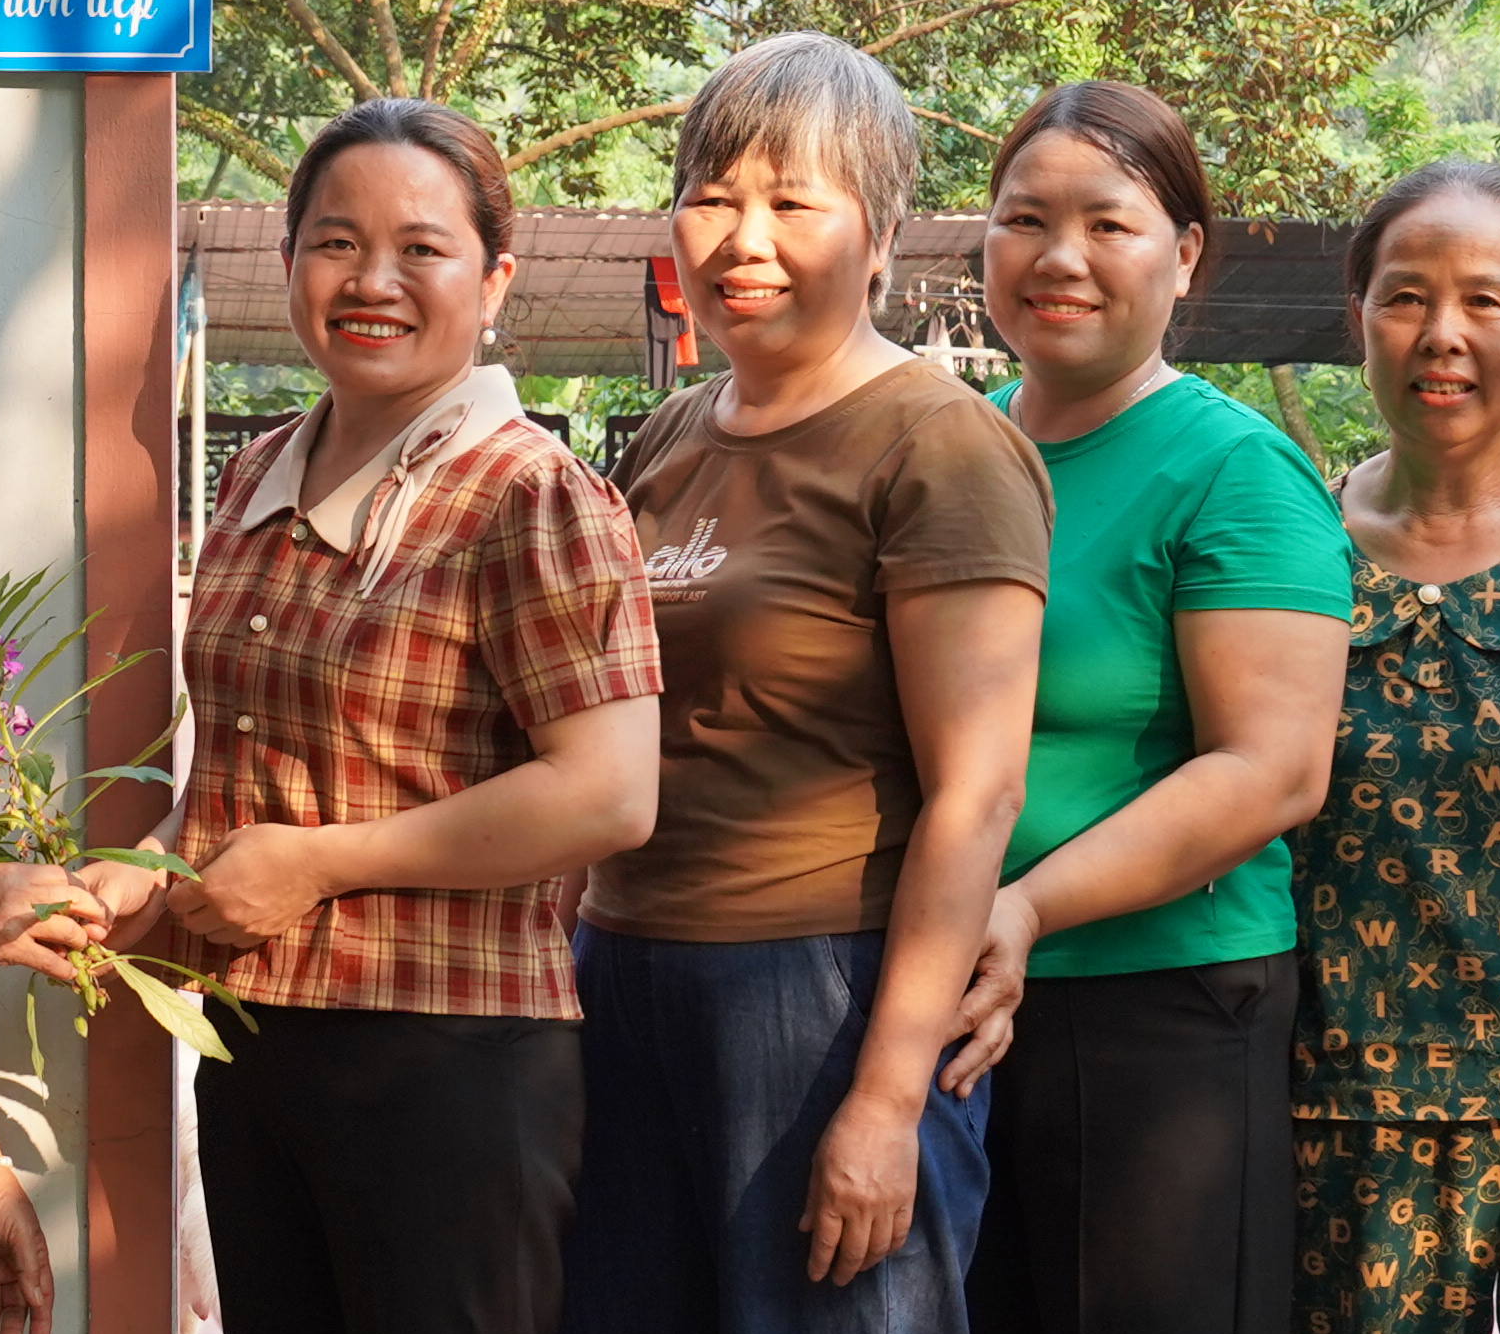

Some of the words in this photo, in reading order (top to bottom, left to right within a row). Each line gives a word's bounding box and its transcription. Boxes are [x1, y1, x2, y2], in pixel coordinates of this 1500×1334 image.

[1365, 734, 1393, 758] Z
[1424, 727, 1453, 751] R
[1352, 783, 1382, 809] C
[1435, 792, 1462, 817] Z
[1432, 849, 1462, 875] R
[1356, 921, 1396, 946] W
